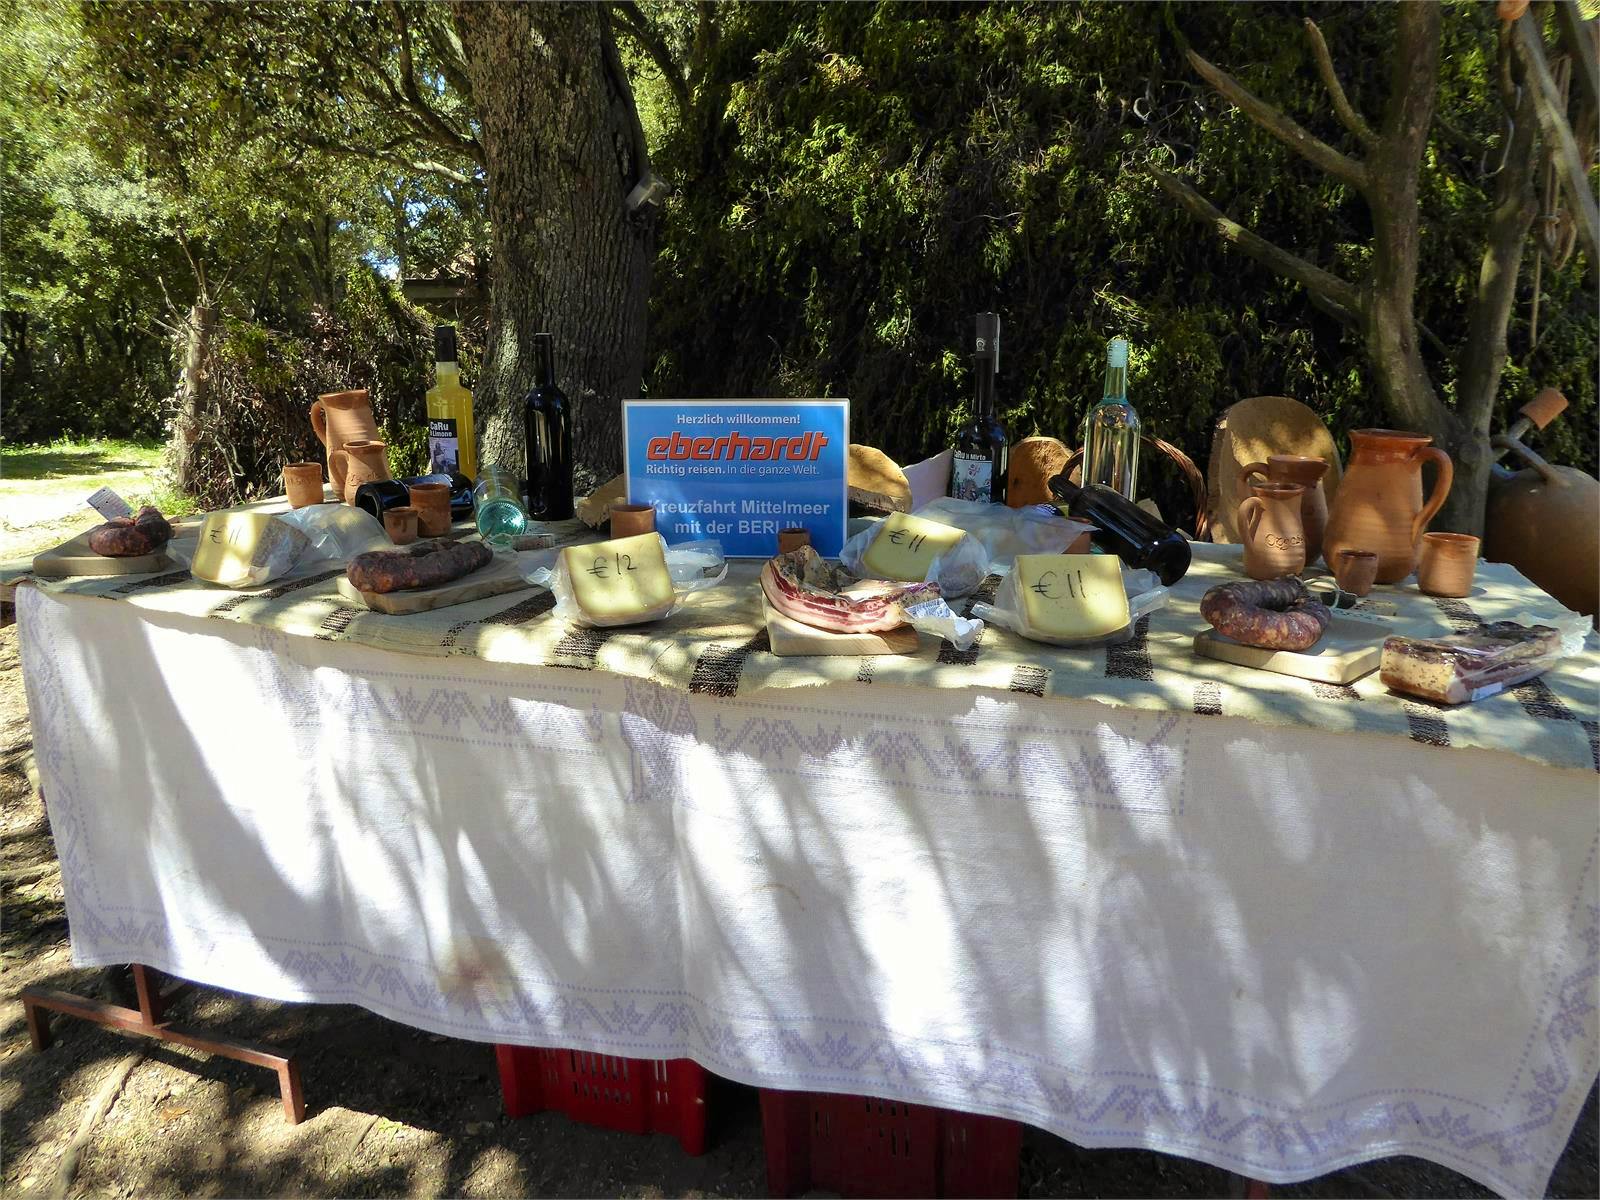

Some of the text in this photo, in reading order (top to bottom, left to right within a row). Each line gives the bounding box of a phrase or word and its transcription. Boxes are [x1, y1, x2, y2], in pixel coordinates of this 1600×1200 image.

[676, 413, 801, 425] Herzlich willkommen!
[647, 431, 828, 461] eberhardt
[646, 464, 820, 477] Richtig reisen. In die ganze Welt.
[741, 499, 831, 515] Mittelmeer
[674, 520, 702, 534] mit
[706, 520, 733, 534] der
